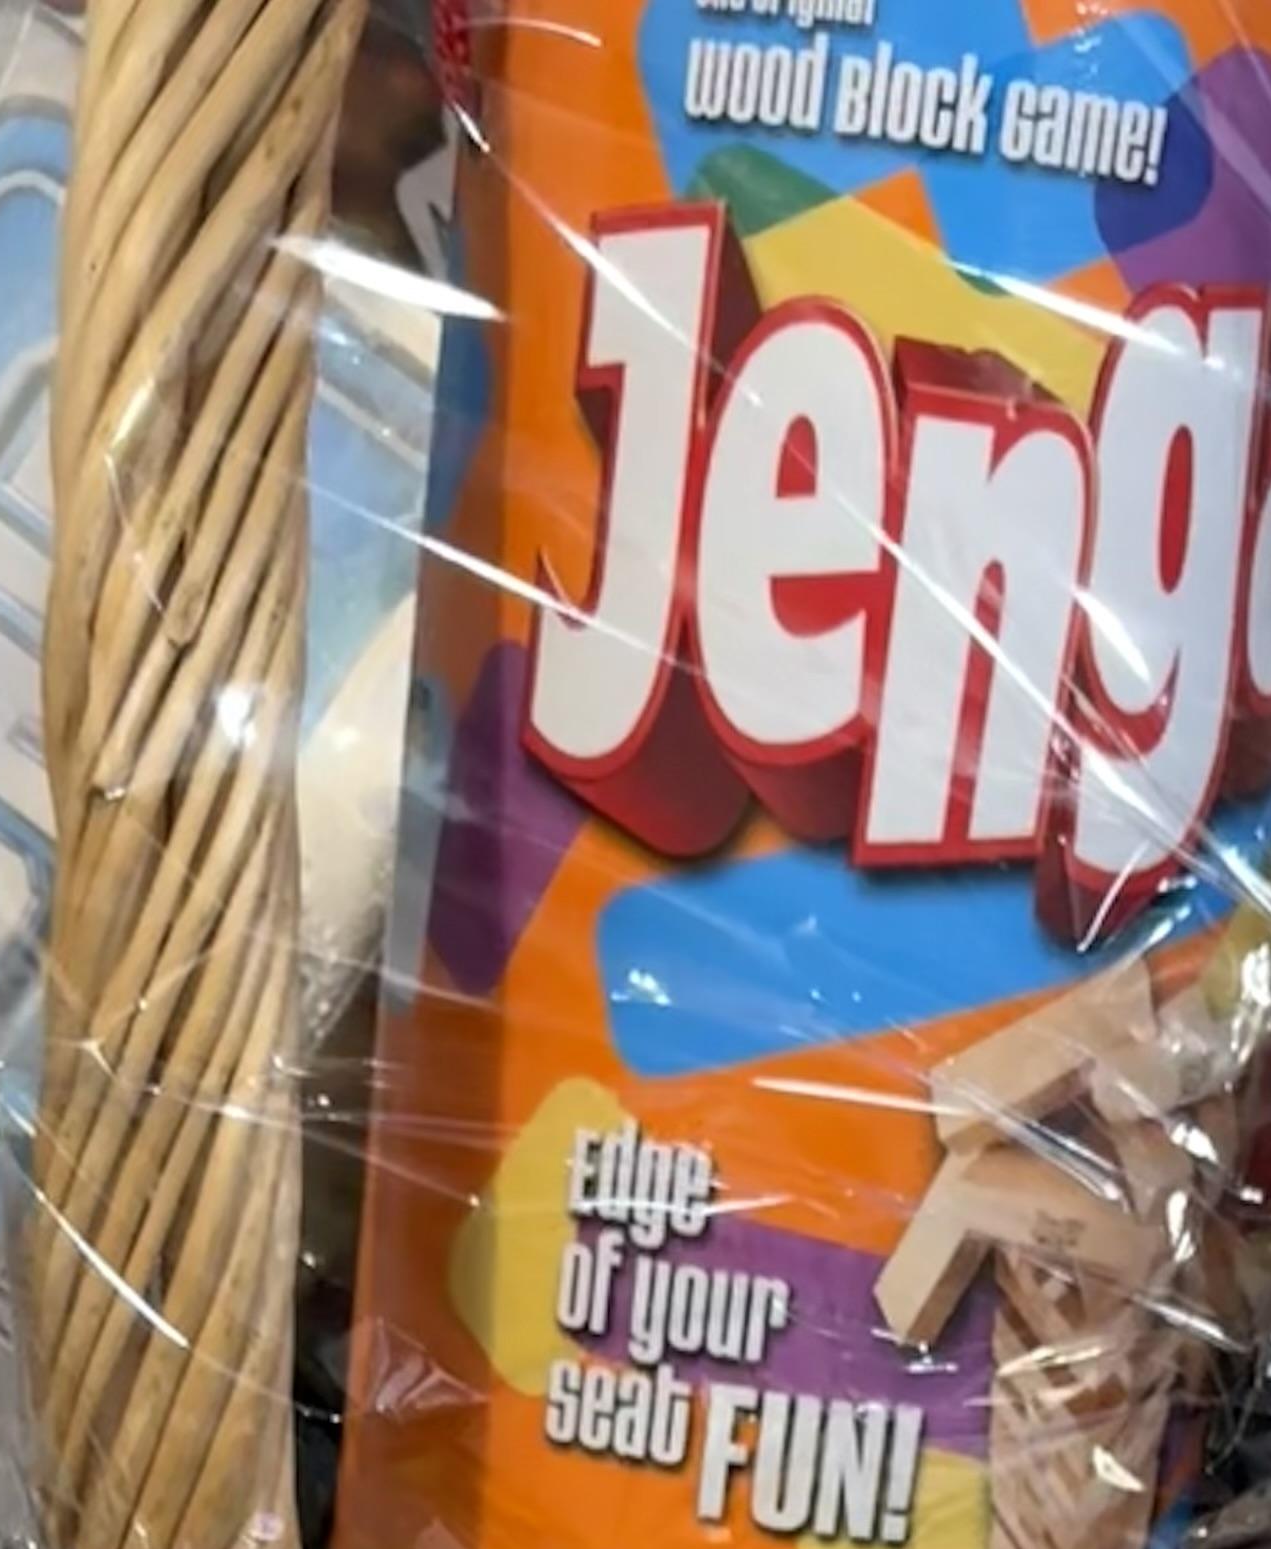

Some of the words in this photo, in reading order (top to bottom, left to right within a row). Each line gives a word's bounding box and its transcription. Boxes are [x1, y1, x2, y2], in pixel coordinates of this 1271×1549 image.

[684, 33, 827, 131] wood
[999, 77, 1168, 185] Game!
[569, 1117, 712, 1248] Edge
[557, 1230, 624, 1334] of
[628, 1256, 790, 1363] your
[546, 1359, 692, 1465] seat
[696, 1381, 924, 1543] FUN!
